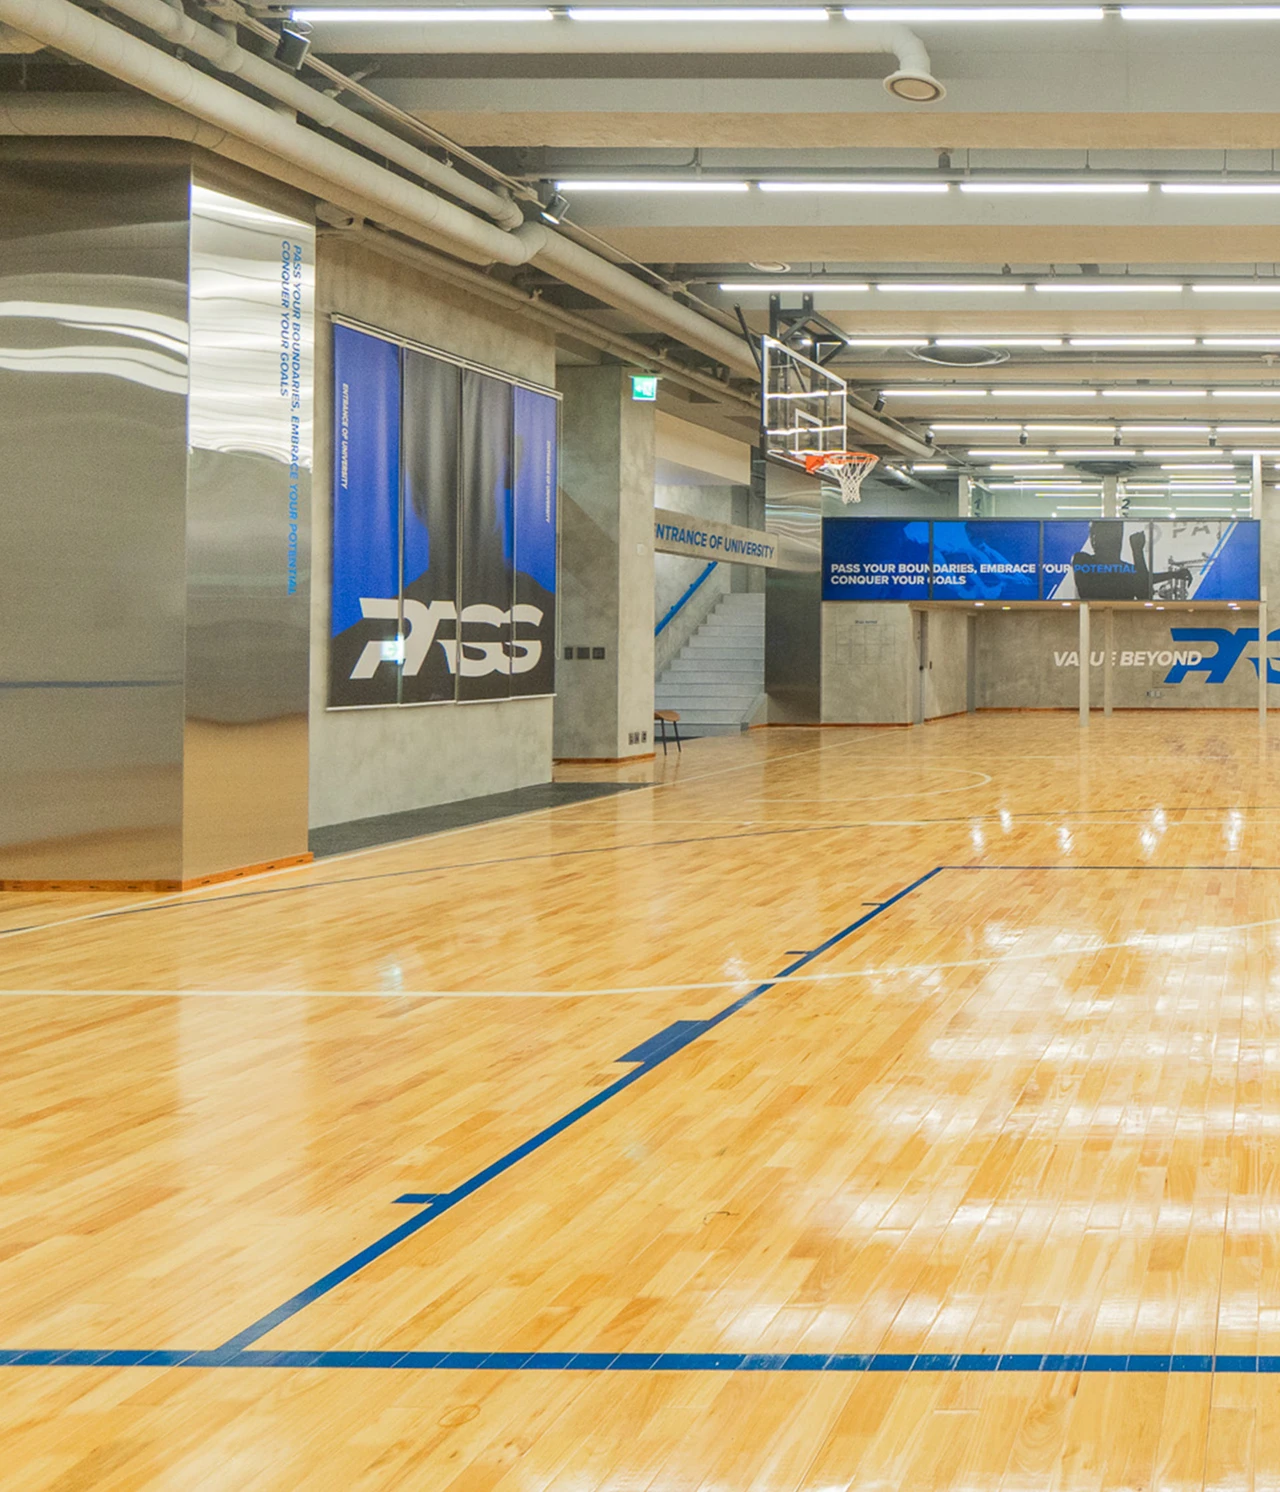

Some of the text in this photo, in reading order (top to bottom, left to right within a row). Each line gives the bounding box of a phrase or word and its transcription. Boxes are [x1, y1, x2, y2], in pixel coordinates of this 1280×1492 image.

[280, 240, 291, 397] CONQUER YOUR GOALS
[287, 244, 302, 596] PASS YOUR BOUNDARIES, EMBRACE YOUR POTENTIAL
[341, 427, 349, 440] OF
[655, 523, 775, 559] NTRANCE OF UNIVERSITY
[831, 564, 860, 573] PASS
[863, 564, 895, 573] YOUR
[898, 564, 977, 574] BOUNDARIES,
[980, 564, 1036, 573] EMBRACE
[1073, 564, 1137, 574] POTENTIAL
[831, 575, 889, 585] CONQUER
[891, 575, 924, 585] YOUR
[350, 598, 544, 680] PASS
[1119, 650, 1203, 667] BEYOND
